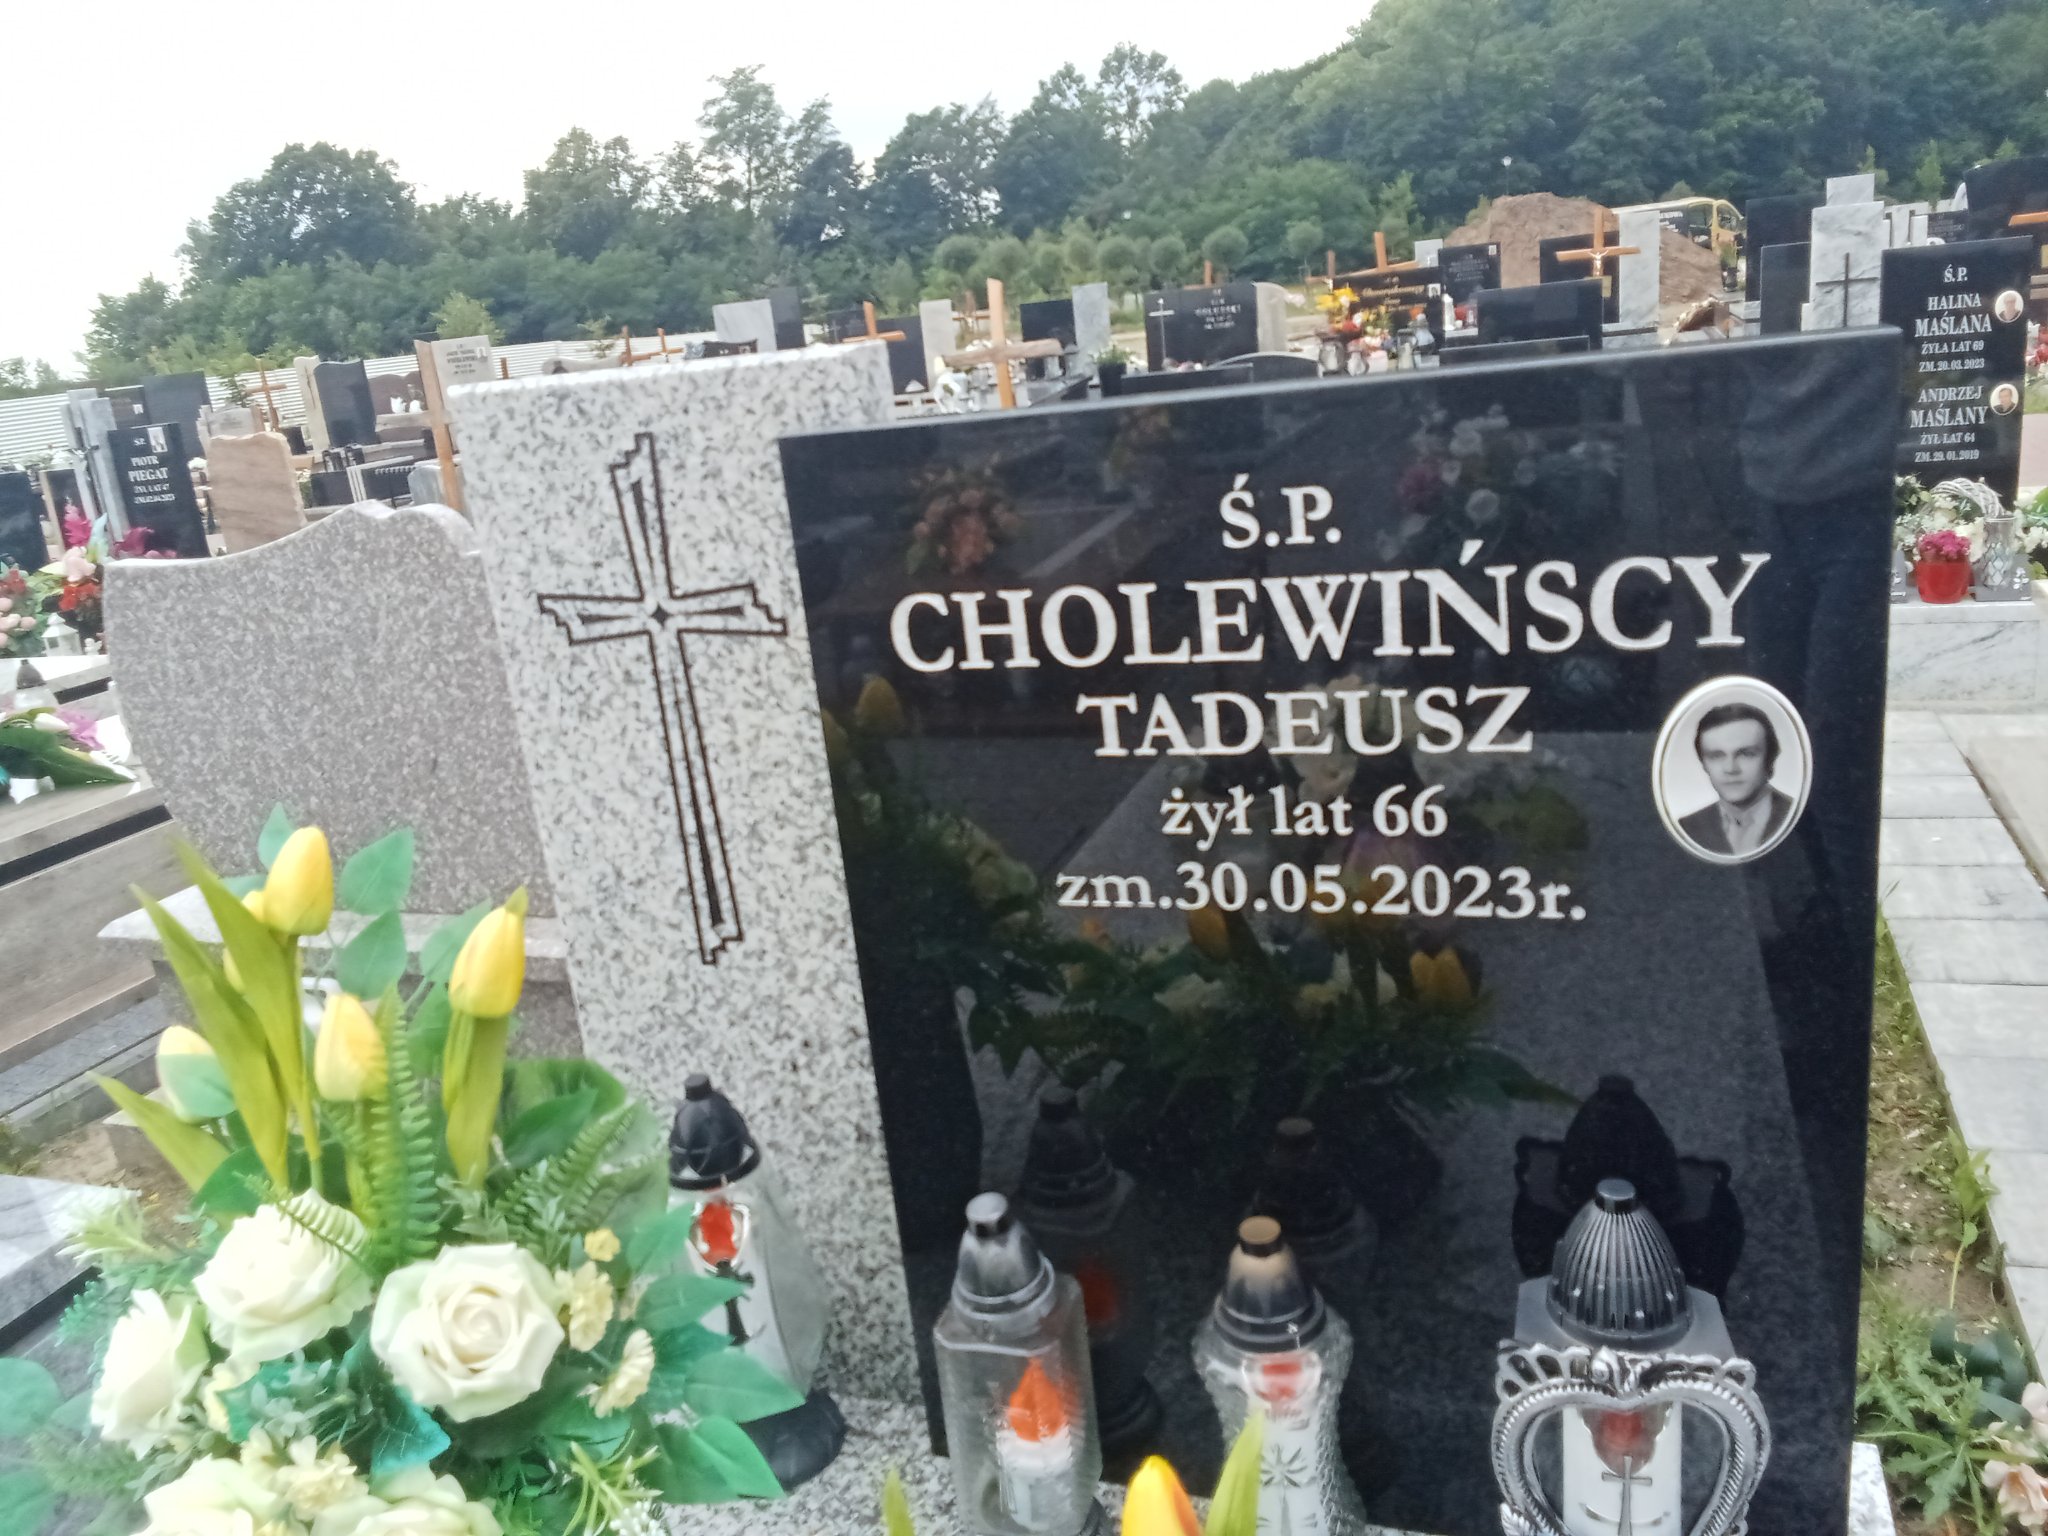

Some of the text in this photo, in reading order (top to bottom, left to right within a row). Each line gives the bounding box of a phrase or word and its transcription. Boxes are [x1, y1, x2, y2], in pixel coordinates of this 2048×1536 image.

[1927, 293, 1982, 311] HALINA
[1914, 311, 1992, 337] MAŚLANA
[1921, 340, 1985, 355] ŻYŁA LAT 69
[1918, 386, 1984, 402] ANDRZEJ
[1910, 403, 1988, 428] MAŚLANY
[1920, 432, 1941, 445] ŻYŁ
[1942, 432, 1963, 444] LAT
[130, 455, 159, 467] PIOTR
[127, 467, 168, 482] PIEGAT
[1220, 474, 1342, 549] Ś.P.
[889, 540, 1771, 673] CHOLEWIŃSCY
[1077, 686, 1533, 760] TADEUSZ
[1160, 784, 1448, 851] żył lat 66
[1055, 861, 1587, 922] zm.30.05.2023r.
